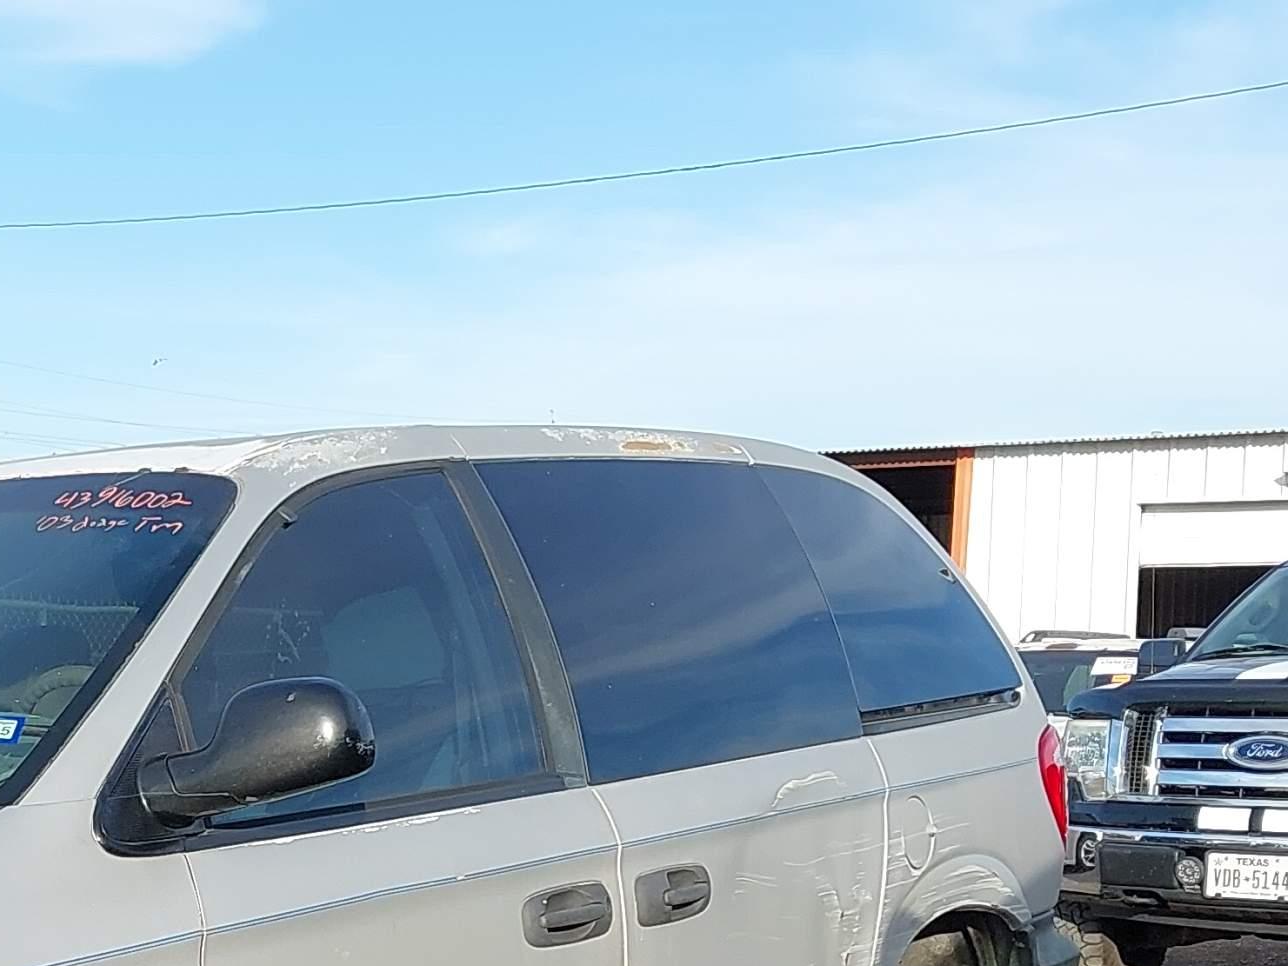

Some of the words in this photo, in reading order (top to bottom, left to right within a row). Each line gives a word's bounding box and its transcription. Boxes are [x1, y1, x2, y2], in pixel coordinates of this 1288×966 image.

[54, 486, 193, 510] 43916002
[1246, 742, 1283, 758] Ford
[1236, 857, 1270, 867] TEXAS
